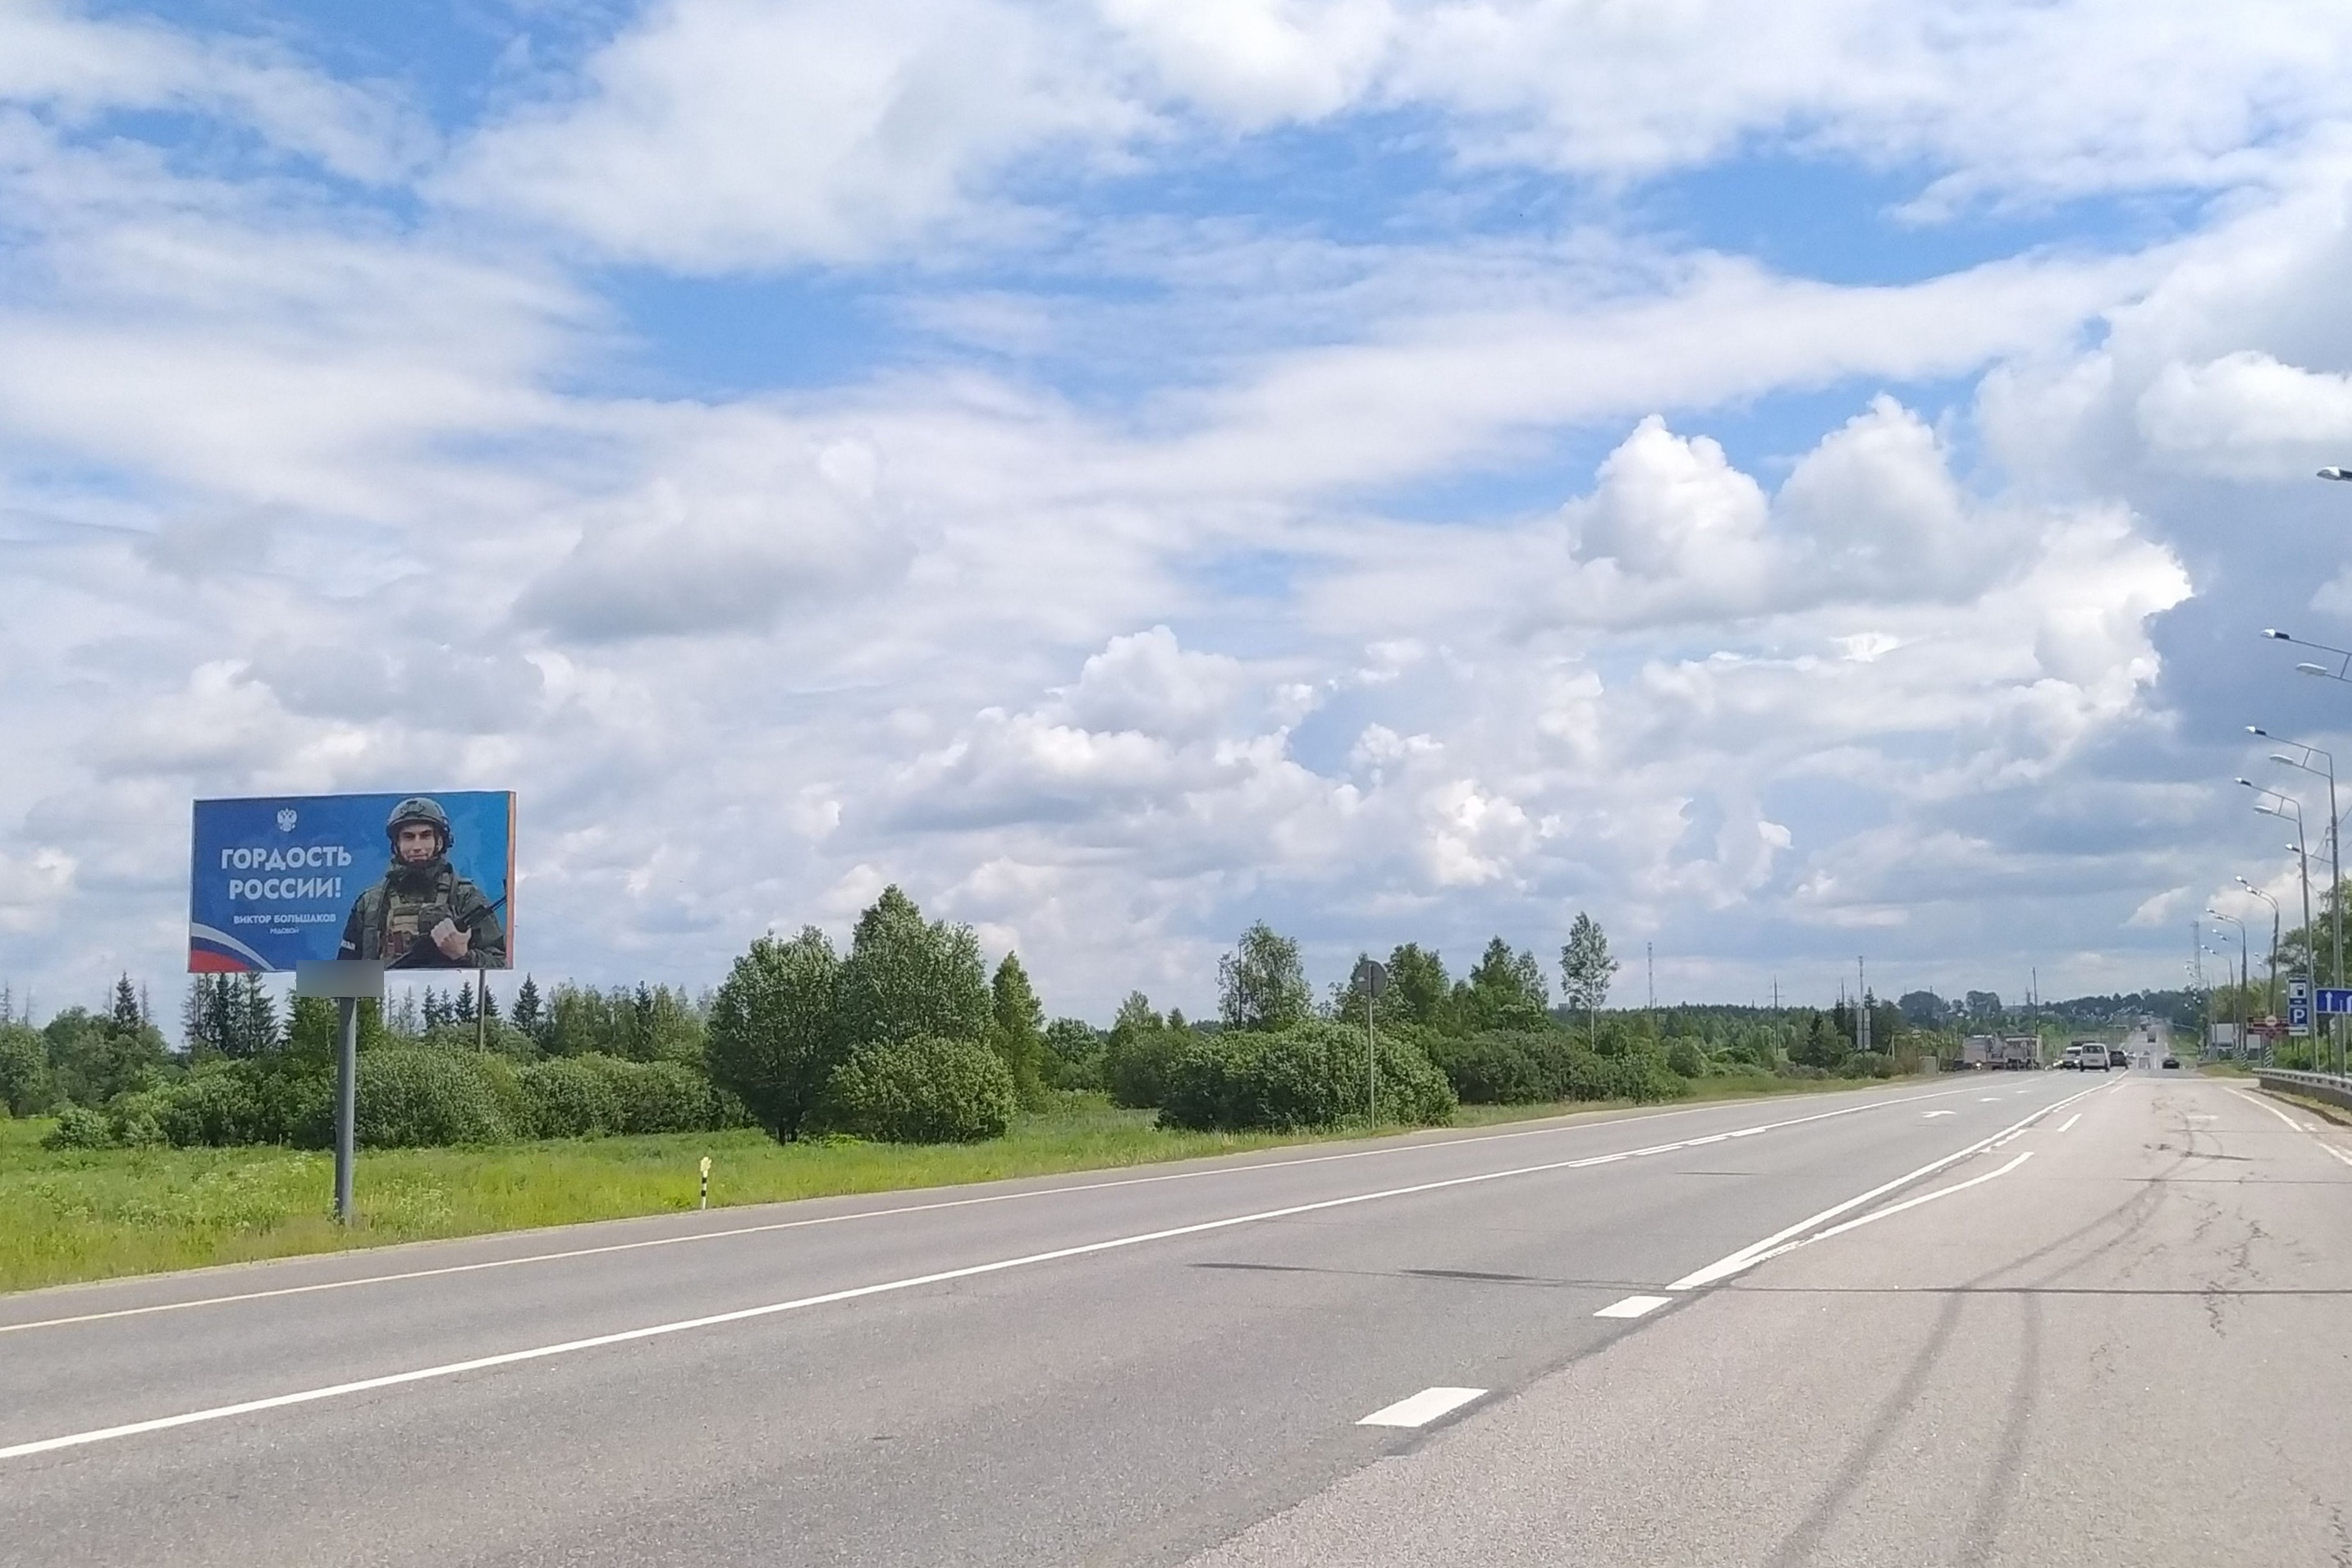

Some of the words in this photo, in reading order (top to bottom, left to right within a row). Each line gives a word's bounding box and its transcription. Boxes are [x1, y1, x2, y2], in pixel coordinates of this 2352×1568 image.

[222, 846, 352, 871] ГОРДОСТЬ
[229, 877, 341, 900] РОССИИ!
[233, 915, 272, 925] ВИКТОР
[273, 913, 336, 924] БОЛЬШАКОВ
